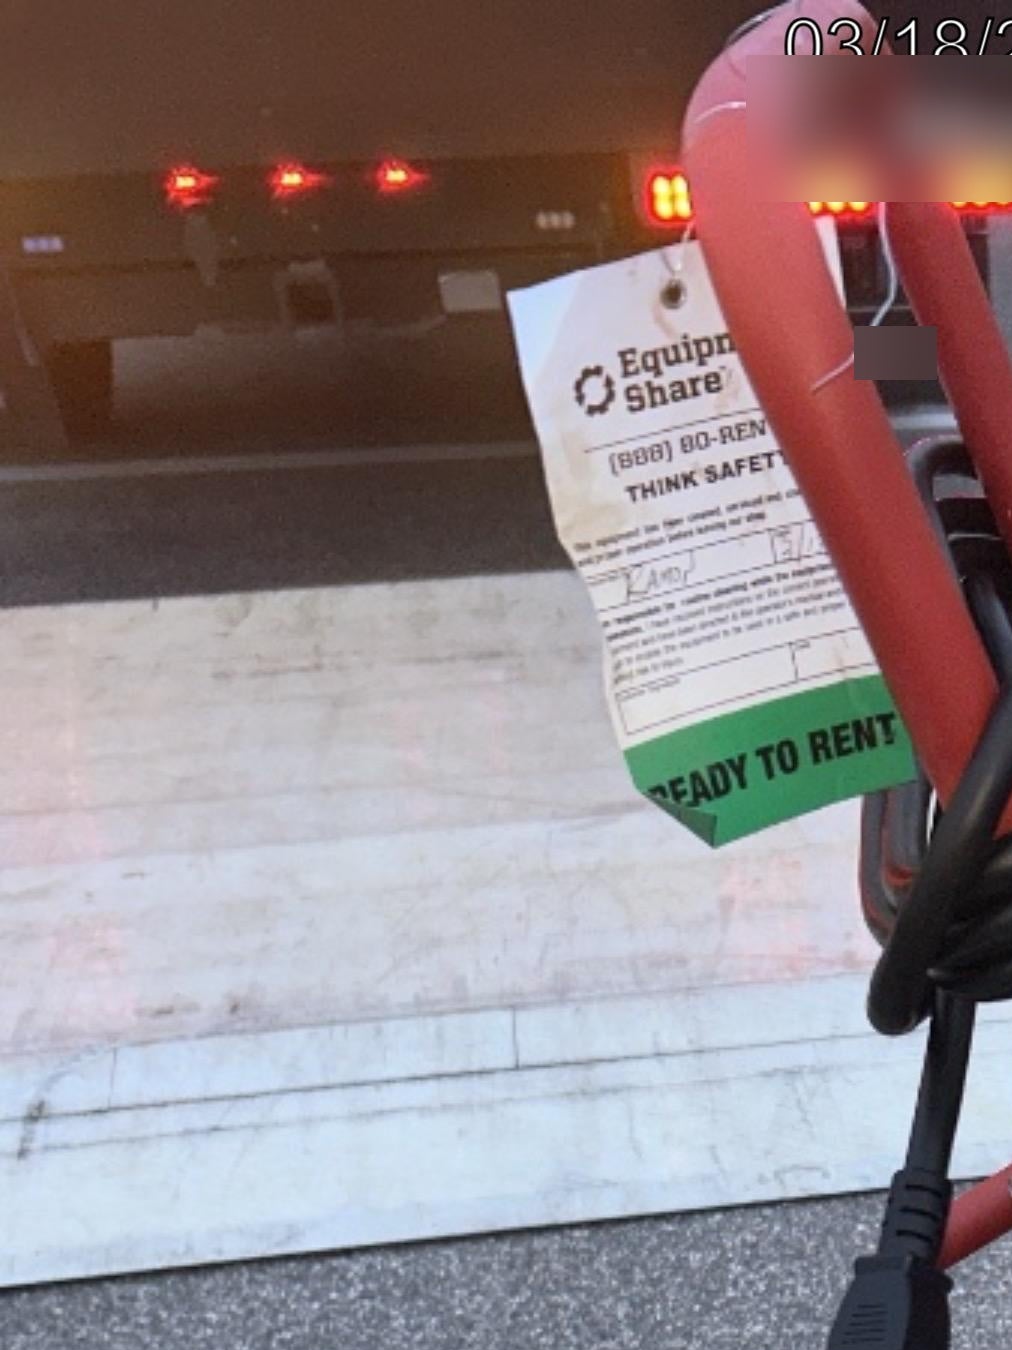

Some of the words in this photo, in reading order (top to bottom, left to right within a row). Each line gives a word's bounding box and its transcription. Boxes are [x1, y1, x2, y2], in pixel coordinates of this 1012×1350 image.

[624, 370, 723, 413] Share
[624, 469, 700, 503] THINK
[755, 738, 800, 782] TO
[807, 711, 897, 766] RENT
